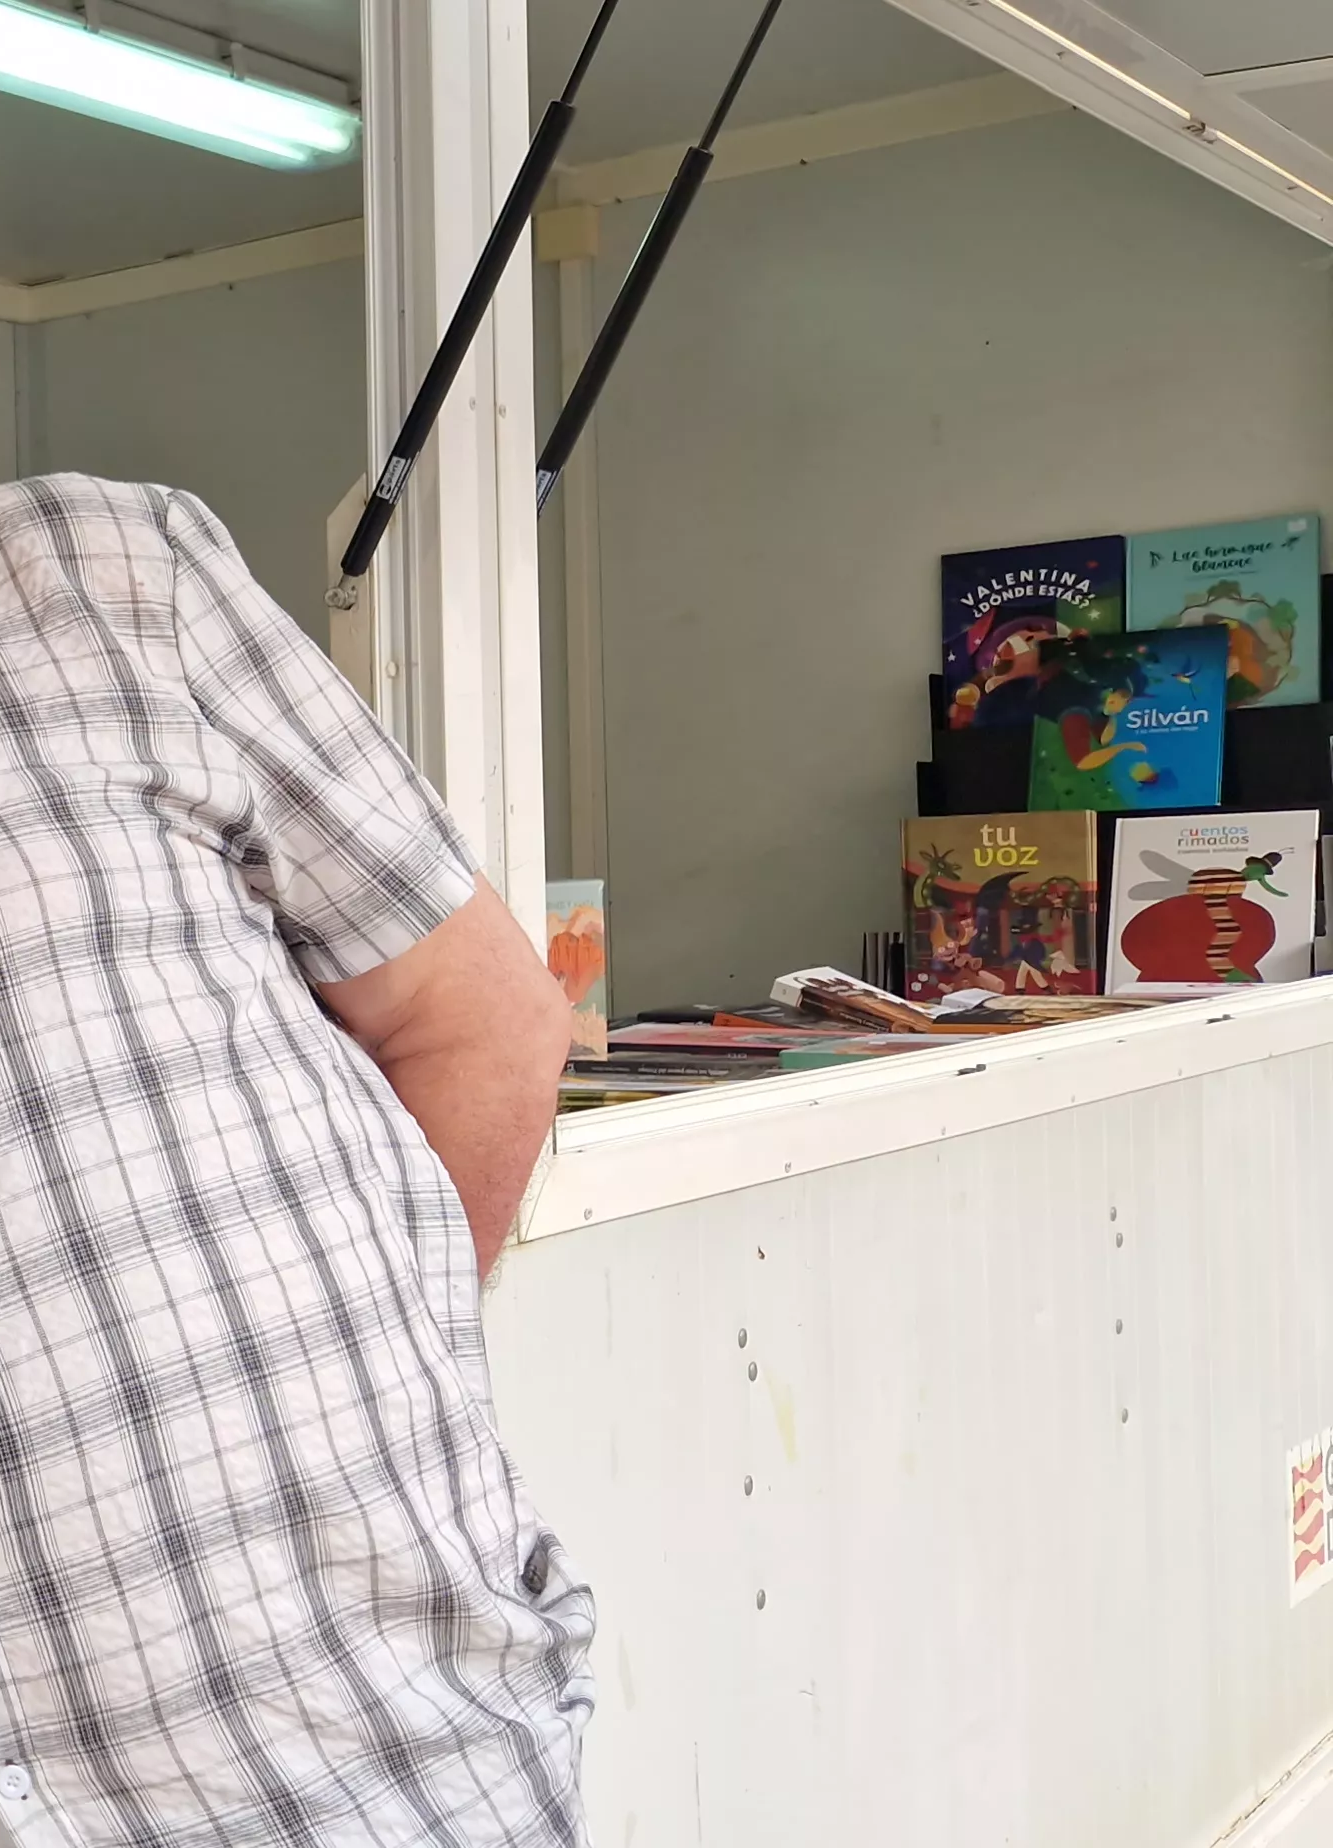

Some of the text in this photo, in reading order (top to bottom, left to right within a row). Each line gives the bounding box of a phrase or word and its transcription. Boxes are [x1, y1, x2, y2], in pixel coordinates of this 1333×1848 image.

[973, 584, 1091, 618] ¿DÓNDE ESTÁS?
[1126, 704, 1209, 729] Silván
[979, 823, 1018, 847] tu
[1177, 833, 1250, 847] rimados
[1180, 826, 1249, 837] cuentos
[973, 845, 1040, 867] voz
